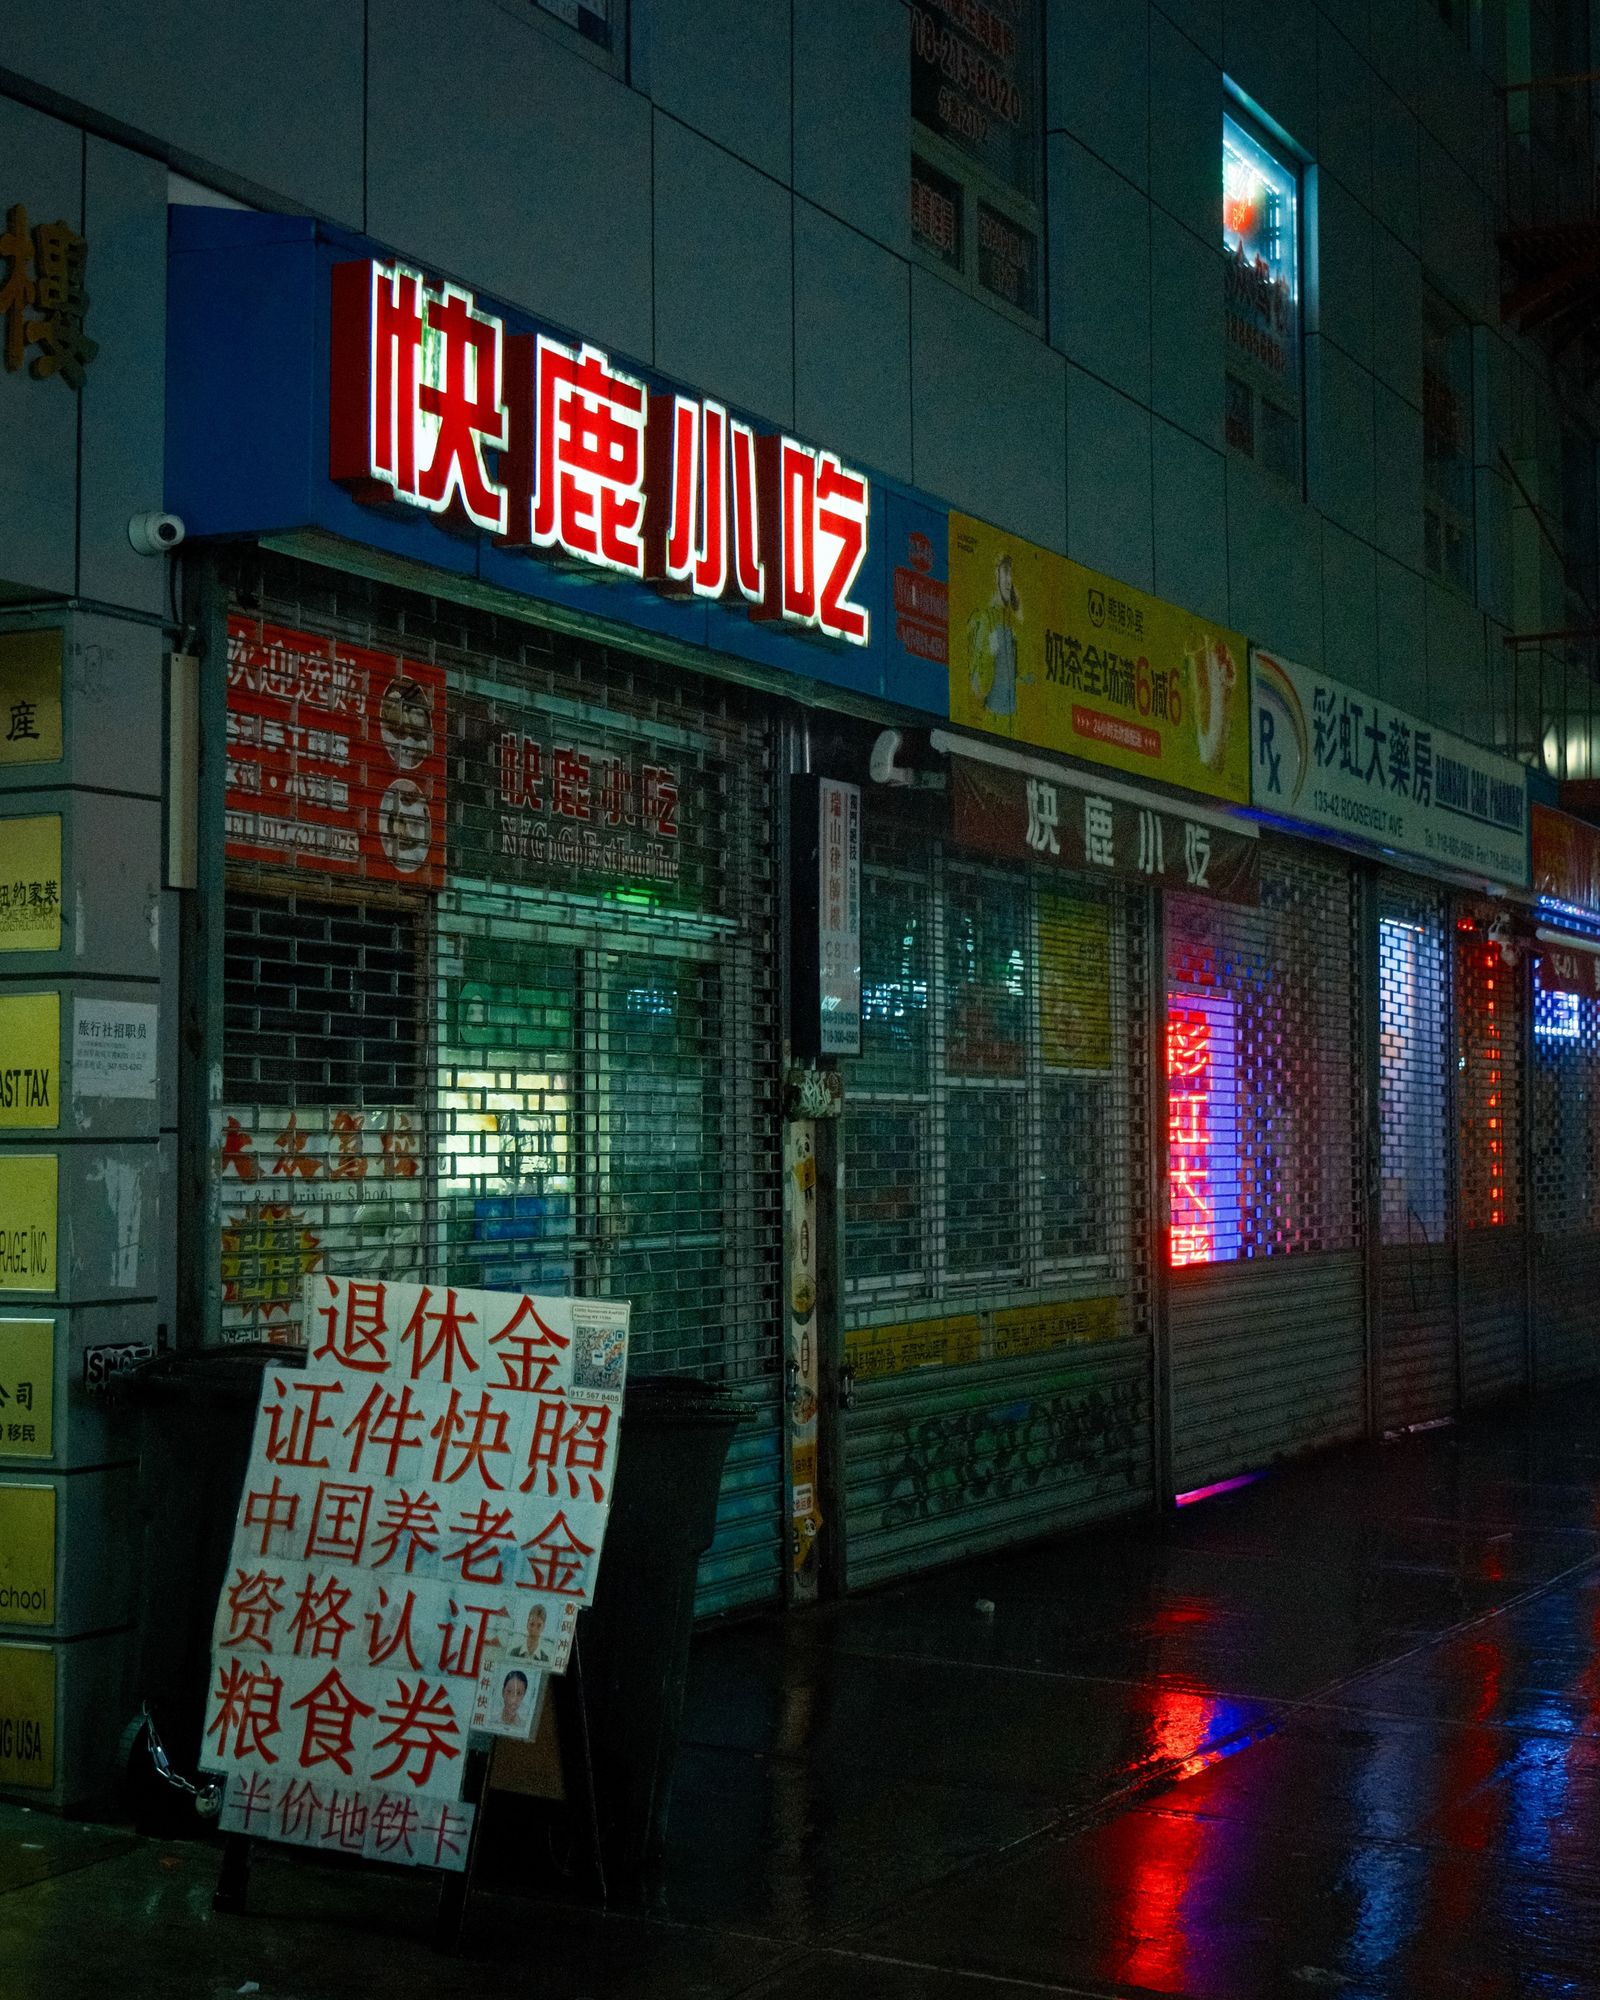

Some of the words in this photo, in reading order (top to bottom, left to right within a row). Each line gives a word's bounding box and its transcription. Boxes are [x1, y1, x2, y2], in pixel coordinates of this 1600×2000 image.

[367, 255, 871, 648] 快鹿小吃
[500, 732, 679, 838] 快鹿小吃
[1313, 686, 1431, 808] 彩虹大藥房
[1026, 778, 1211, 888] 快鹿小吃
[1341, 796, 1387, 833] ROOSEVELT
[1388, 815, 1403, 839] AVE
[78, 1019, 147, 1039] 旅行社招职员
[24, 1069, 49, 1107] TAX
[312, 1275, 571, 1398] 退休金
[264, 1377, 612, 1504] 证件快照
[242, 1476, 595, 1599] 中国养老金
[219, 1567, 511, 1679] 资格认证
[16, 1720, 42, 1761] USA
[206, 1656, 461, 1788] 粮食券
[228, 1769, 469, 1865] 半价地铁卡
